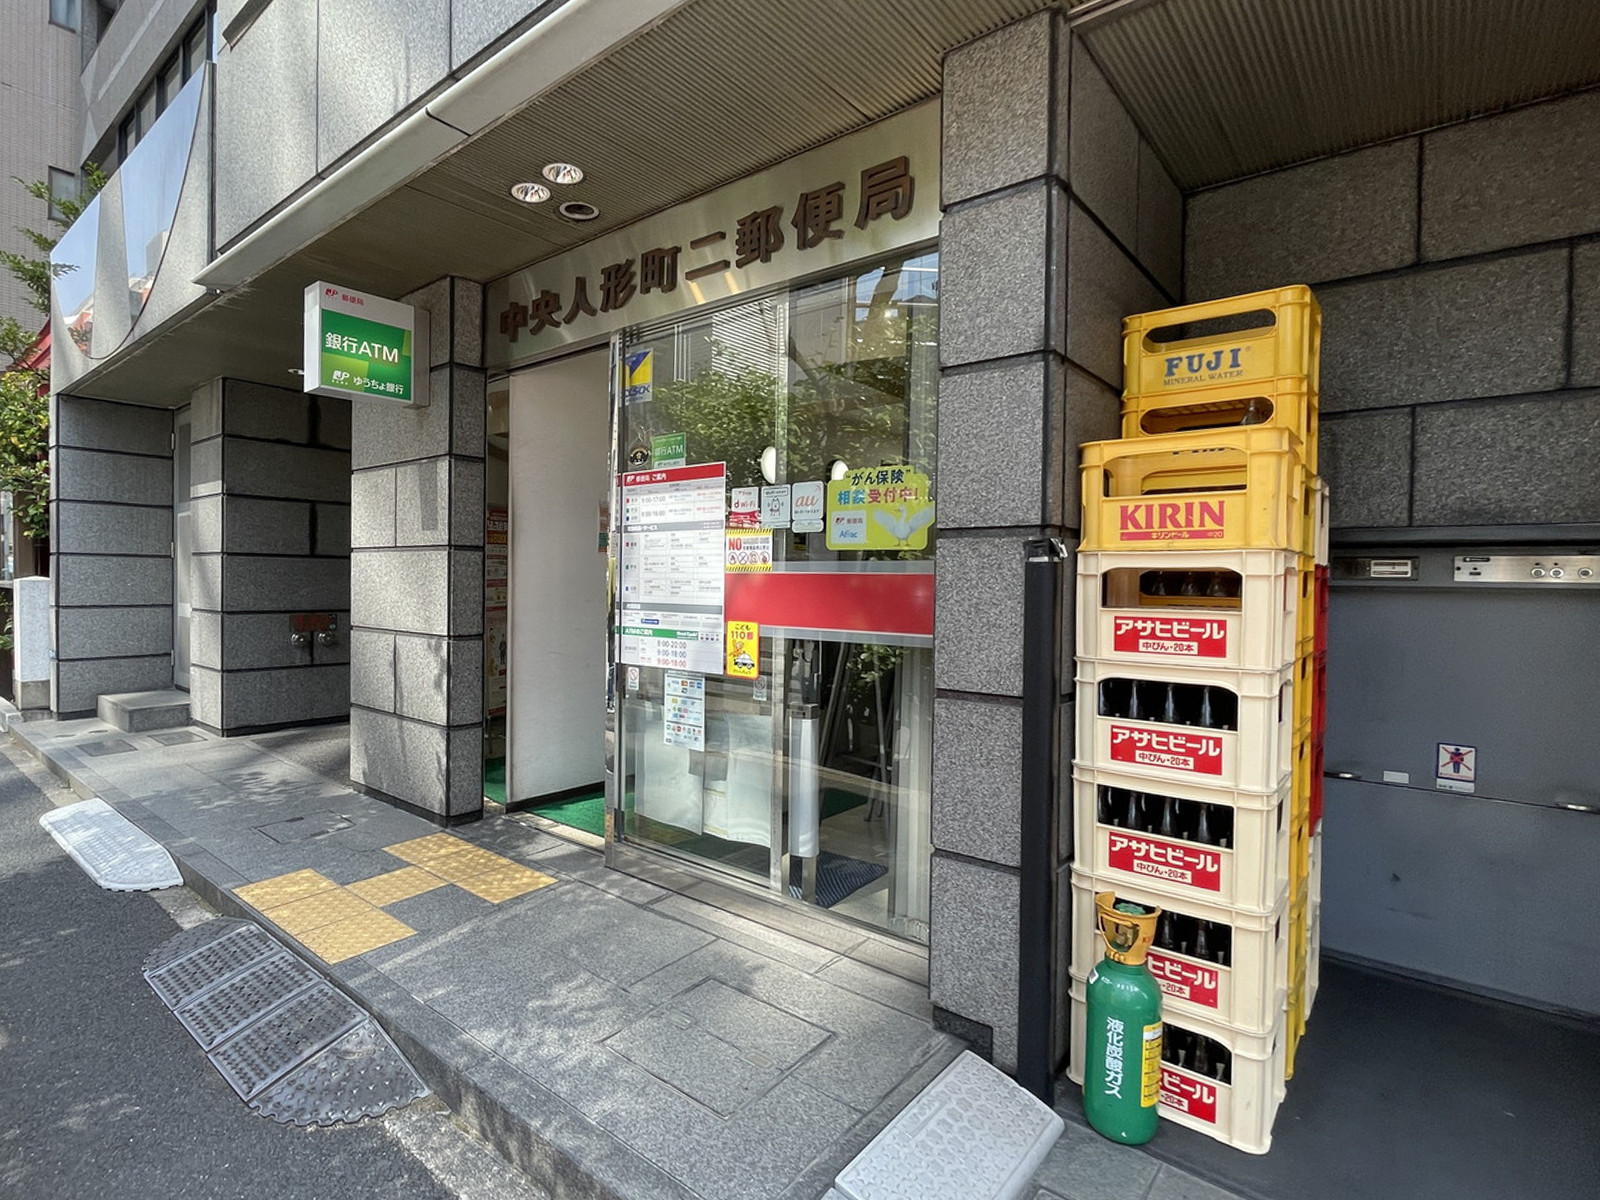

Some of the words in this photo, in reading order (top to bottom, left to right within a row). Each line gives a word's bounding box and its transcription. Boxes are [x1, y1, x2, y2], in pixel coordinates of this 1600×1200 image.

[500, 155, 915, 342] 中央人形町二郵便局
[325, 332, 399, 363] 銀行ATM
[1164, 347, 1242, 377] FUJI
[353, 376, 404, 395] ゆうちょ銀行
[1163, 374, 1206, 386] MINERAL
[1208, 369, 1243, 380] WATER
[1119, 500, 1225, 530] KIRIN
[728, 538, 743, 551] NO
[1116, 619, 1225, 640] アサヒビール
[1141, 641, 1195, 652] 中びん・20本
[1112, 728, 1221, 756] アサヒビール
[1137, 752, 1191, 767] 中びん・20本
[1110, 836, 1219, 873] アサヒビール
[1136, 862, 1188, 880] 中びん・20本
[1147, 955, 1216, 989] ヒビール
[1159, 982, 1186, 995] ・20本
[1104, 1016, 1125, 1099] 液化炭酸ガス
[1160, 1071, 1215, 1105] ビール
[1161, 1093, 1185, 1107] ・20本
